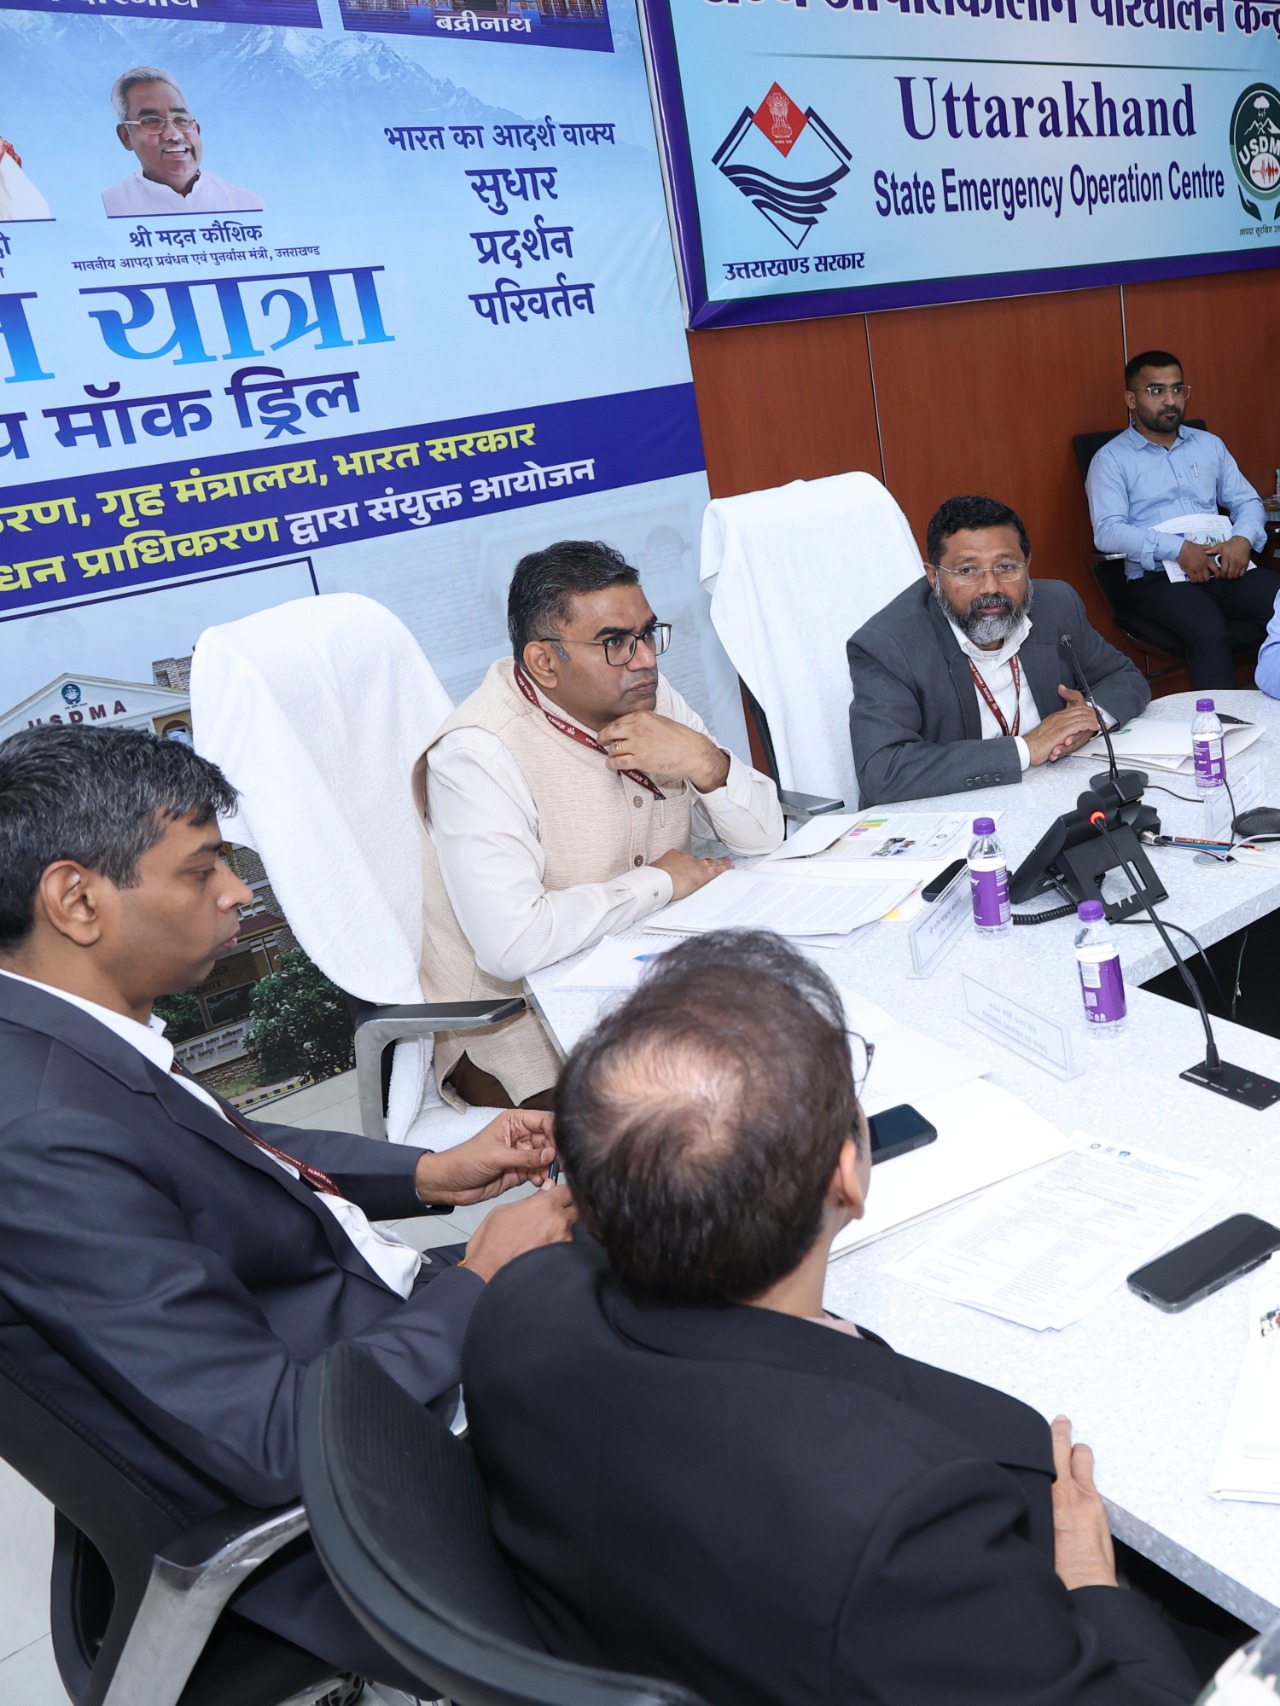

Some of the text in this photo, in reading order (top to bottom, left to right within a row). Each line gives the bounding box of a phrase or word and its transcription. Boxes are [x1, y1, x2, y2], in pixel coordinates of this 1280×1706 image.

[434, 9, 532, 33] बद्रीनाथ
[384, 115, 616, 151] भारत का आदर्श वाक्य
[894, 76, 1197, 140] Uttarakhand
[464, 167, 558, 215] सुधार
[874, 161, 1225, 221] State Emergency Operation Centre
[71, 245, 321, 272] माननीय आपदा प्रबंधन एवं पुनर्वास मंत्री, उत्तराखण्ड
[129, 220, 263, 248] श्री मदन कौशिक
[469, 214, 574, 269] प्रदर्शन
[722, 252, 865, 281] उत्तराखण्ड सरकार
[78, 265, 395, 365] यात्रा
[468, 272, 595, 325] परिवर्तन
[42, 381, 213, 448] मॉक
[223, 365, 361, 440] ड्रिल
[96, 483, 166, 528] गृह
[170, 458, 328, 503] मंत्रालय,
[333, 442, 420, 477] भारत
[425, 423, 536, 462] सरकार
[72, 517, 280, 578] प्राधिकरण
[284, 501, 359, 545] द्वारा
[364, 486, 463, 526] संयुक्त
[469, 458, 596, 502] आयोजन
